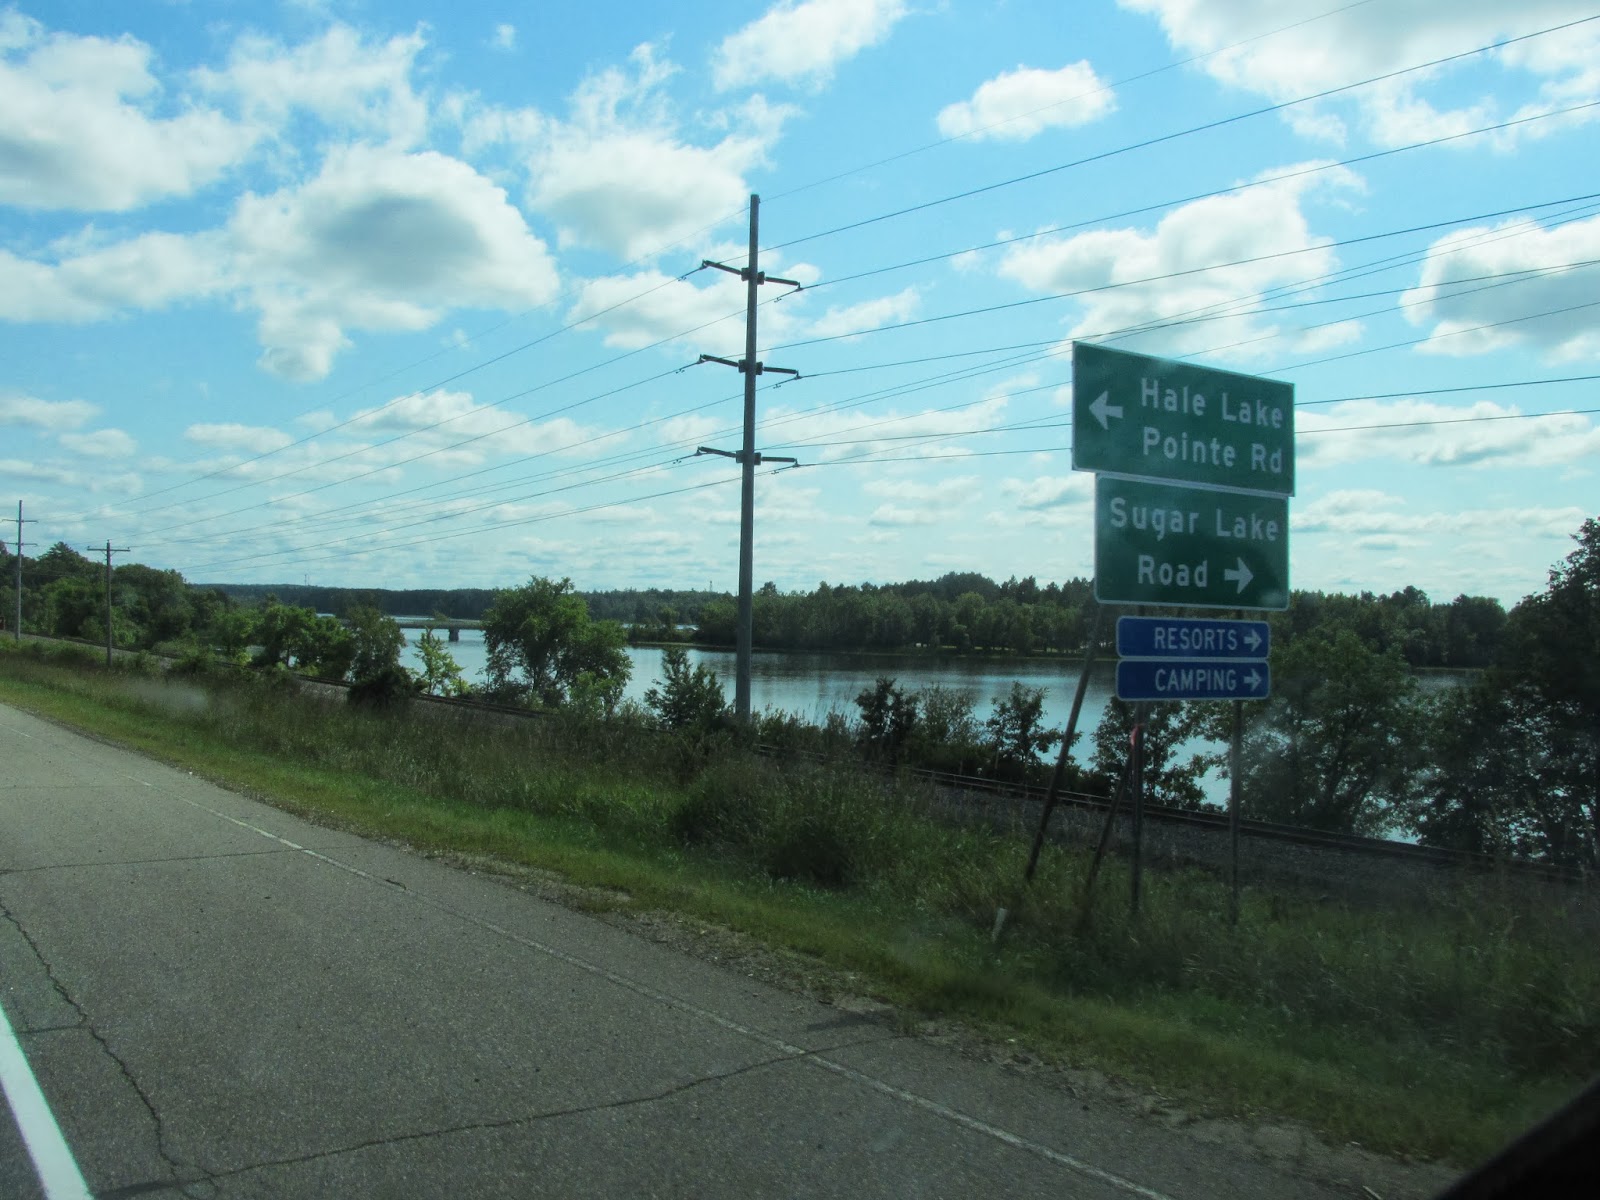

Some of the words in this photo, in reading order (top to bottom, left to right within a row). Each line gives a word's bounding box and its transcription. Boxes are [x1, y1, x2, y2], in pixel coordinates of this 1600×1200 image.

[1140, 377, 1206, 416] Hale
[1222, 392, 1283, 428] Lake
[1142, 426, 1236, 467] Pointe
[1251, 443, 1283, 474] Rd
[1110, 497, 1200, 542] Sugar
[1216, 508, 1279, 542] Lake
[1137, 554, 1208, 588] Road
[1154, 627, 1238, 650] RESORTS
[1155, 668, 1237, 691] CAMPING
